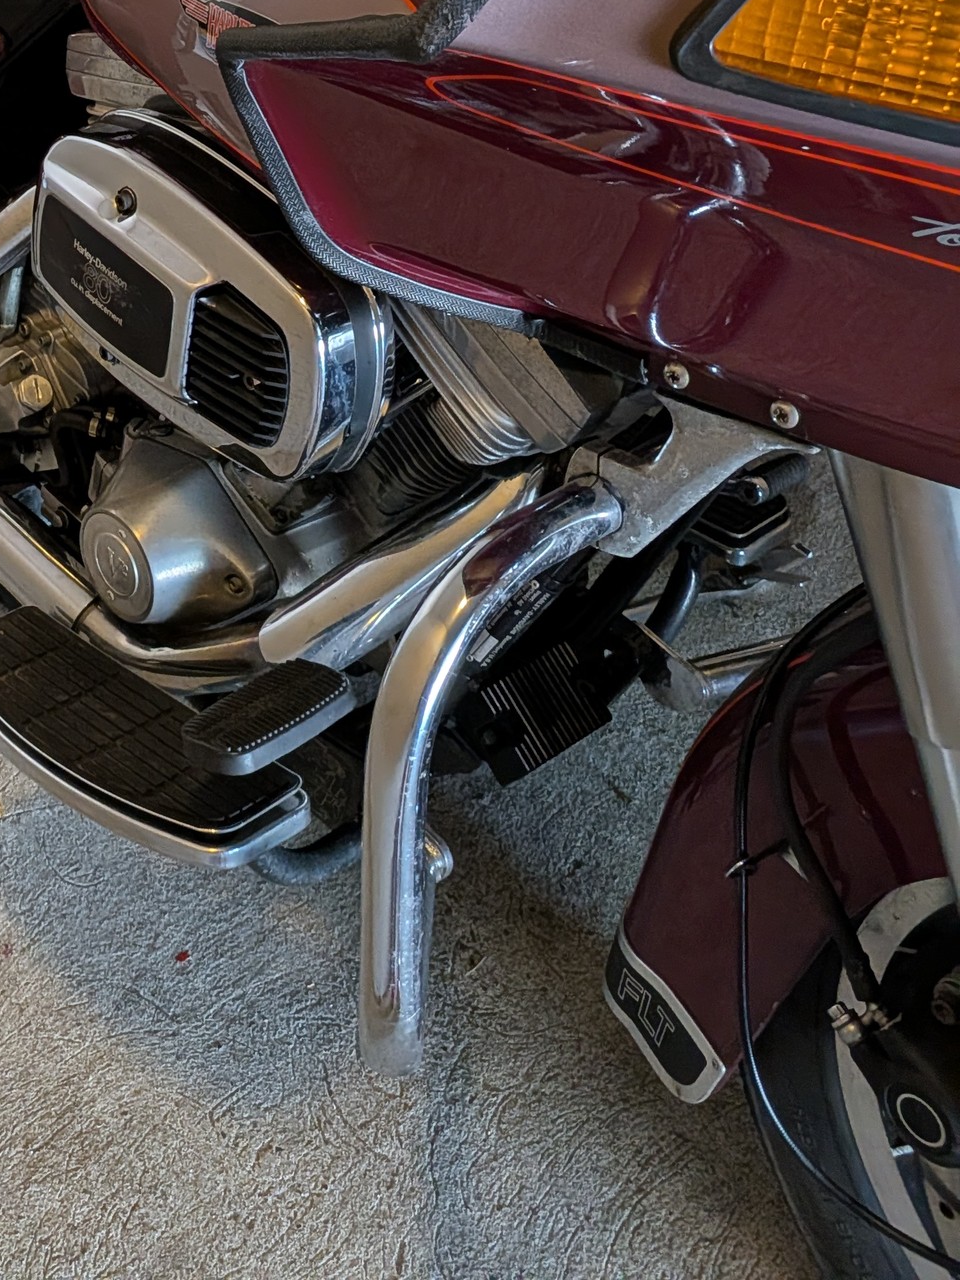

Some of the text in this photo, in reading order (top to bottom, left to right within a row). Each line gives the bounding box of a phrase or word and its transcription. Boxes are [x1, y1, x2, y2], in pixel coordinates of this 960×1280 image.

[73, 238, 128, 291] Harley-Davidson
[83, 262, 112, 305] 80
[617, 968, 676, 1047] FLT
